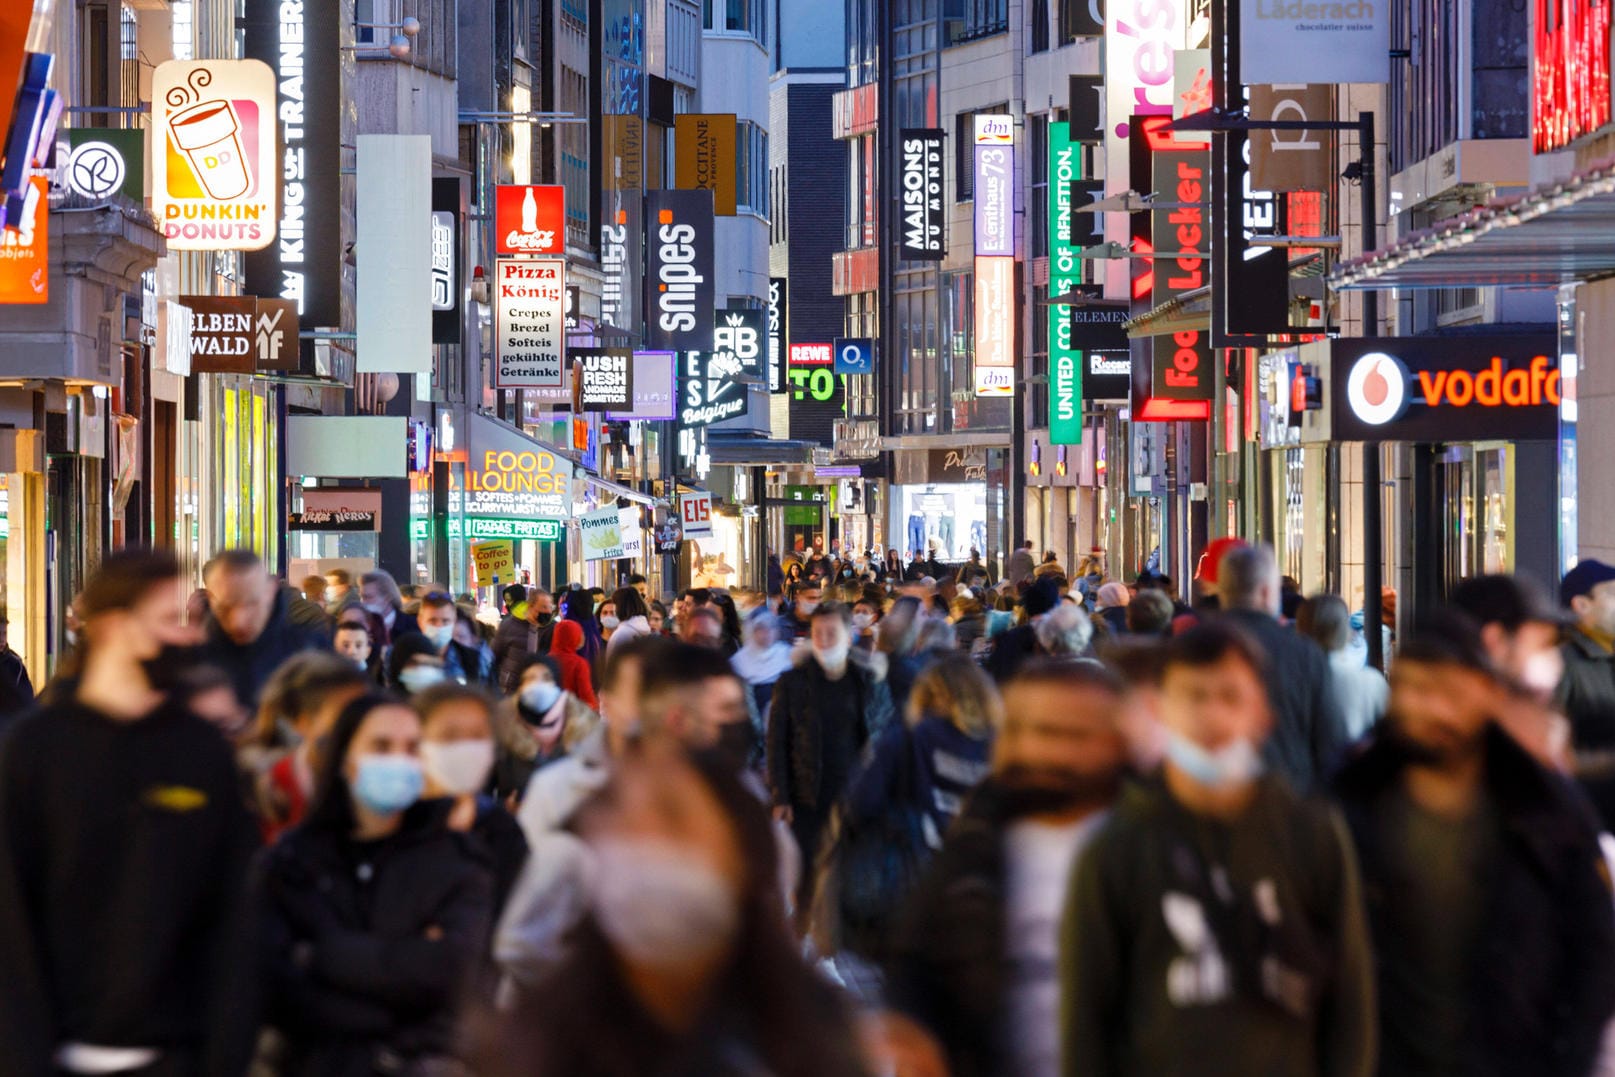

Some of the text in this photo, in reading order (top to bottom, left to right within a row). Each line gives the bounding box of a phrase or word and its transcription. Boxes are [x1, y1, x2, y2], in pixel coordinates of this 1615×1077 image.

[1295, 23, 1374, 31] chocolatier suisse
[279, 0, 304, 144] TRAINER
[983, 120, 1008, 134] dm
[904, 139, 923, 249] MAISONS
[929, 139, 940, 250] DU MONDE
[981, 149, 1005, 250] Eventhaus 73
[165, 204, 266, 220] DUNKIN'
[279, 182, 304, 263] KING
[165, 223, 261, 240] DONUTS
[1057, 247, 1073, 272] OF
[505, 265, 556, 279] Pizza
[659, 224, 703, 332] snipes
[1165, 162, 1202, 388] Foo Locker
[502, 284, 560, 301] König
[509, 308, 552, 320] Crepes
[1058, 278, 1073, 350] COLOS
[1075, 312, 1130, 323] ELEMEN
[510, 323, 550, 333] Brezel
[190, 336, 249, 355] WALD
[508, 337, 552, 348] Softeis
[503, 352, 558, 363] gekühlte
[791, 346, 830, 361] REWE
[500, 367, 559, 378] Getränke
[584, 372, 626, 385] RESH
[984, 371, 1008, 385] dm
[1058, 357, 1074, 420] UNITED
[583, 394, 626, 403] OSMETICS
[682, 398, 743, 424] Belgique
[485, 450, 555, 473] FOOD
[473, 470, 567, 494] LOUNGE
[684, 498, 710, 523] EIS
[476, 522, 553, 535] PAPAS FRITAS
[581, 516, 619, 529] Pommes
[623, 540, 640, 550] urst
[477, 548, 509, 560] Coffee
[603, 548, 624, 558] Frites
[479, 560, 508, 571] to go
